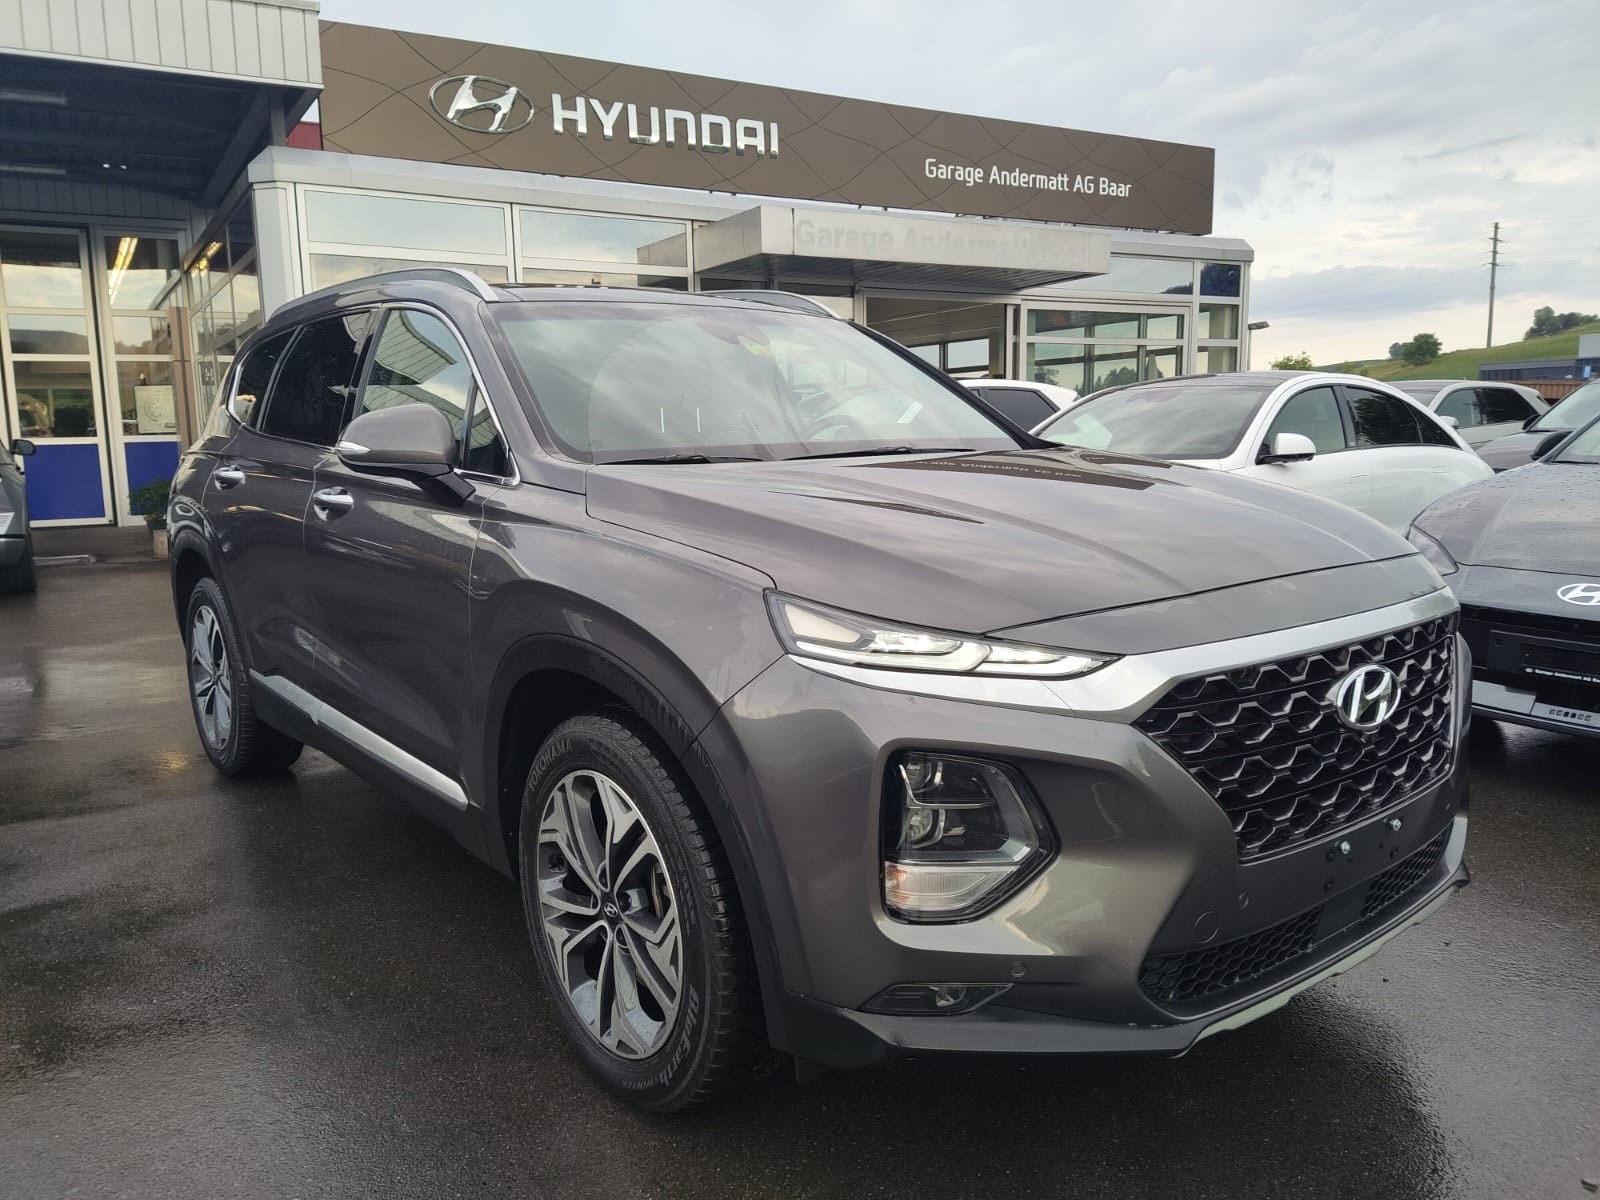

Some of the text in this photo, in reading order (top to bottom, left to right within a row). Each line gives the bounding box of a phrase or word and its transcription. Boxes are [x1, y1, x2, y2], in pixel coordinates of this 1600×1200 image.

[551, 92, 780, 159] HYUNDAI
[924, 157, 1133, 199] Garage Andermatt AG Baar
[795, 218, 894, 251] Garage
[527, 737, 574, 792] YOKOHAMA
